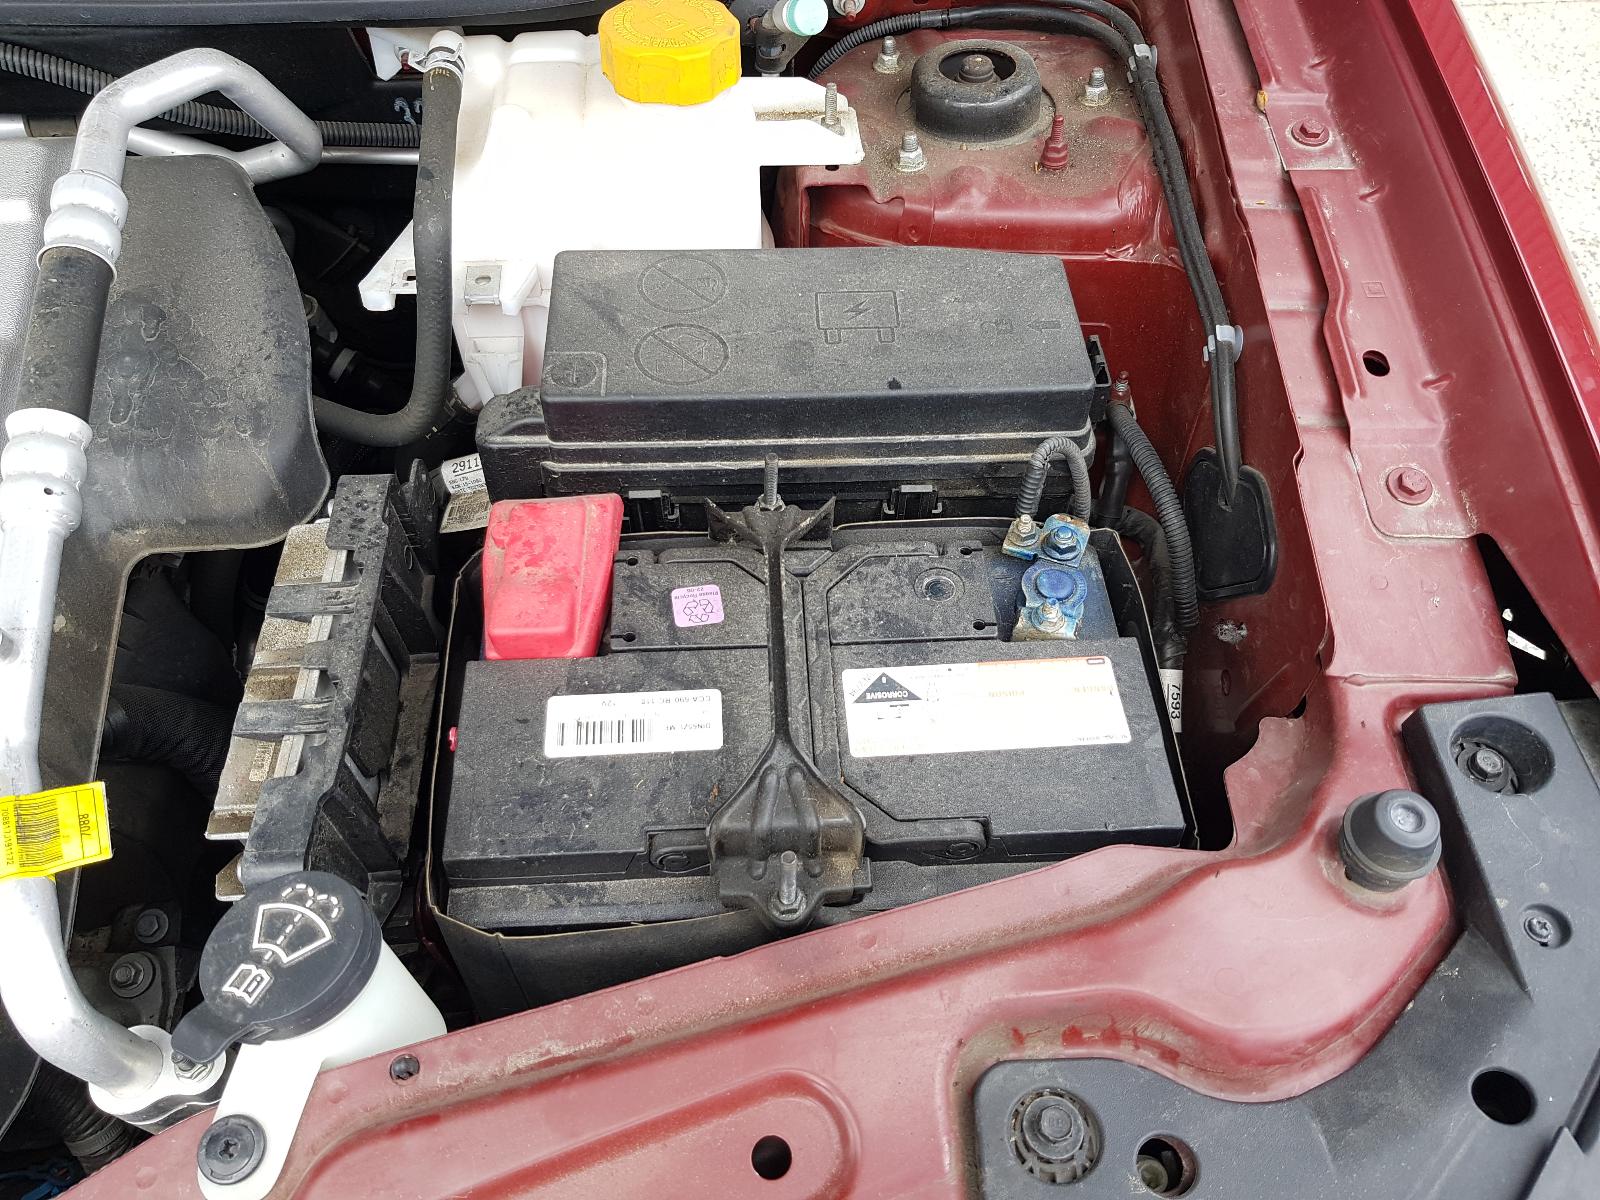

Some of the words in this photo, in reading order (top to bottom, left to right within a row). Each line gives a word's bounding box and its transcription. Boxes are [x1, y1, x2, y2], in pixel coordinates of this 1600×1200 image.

[452, 457, 479, 474] 2911
[866, 690, 909, 700] CORROSIVE
[1170, 683, 1181, 719] 7593
[79, 813, 91, 837] 7088
